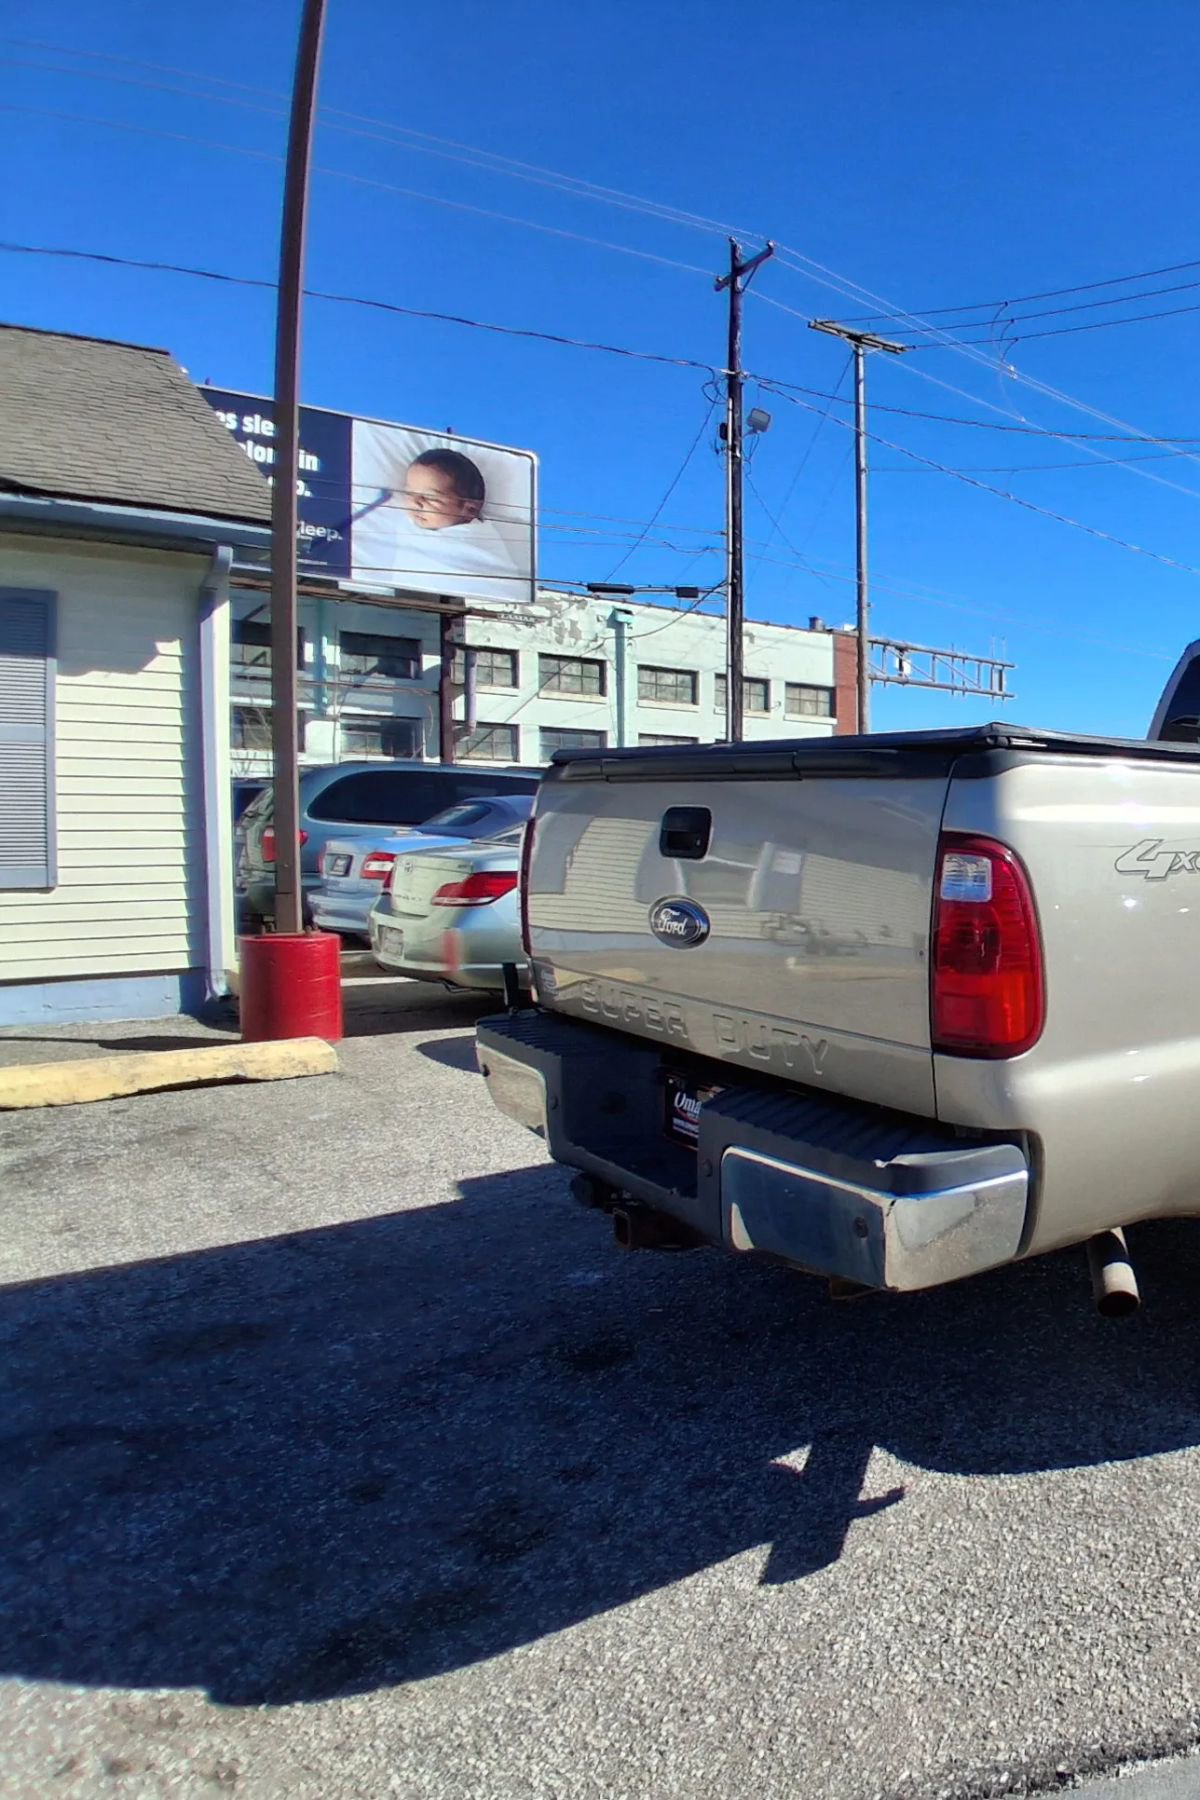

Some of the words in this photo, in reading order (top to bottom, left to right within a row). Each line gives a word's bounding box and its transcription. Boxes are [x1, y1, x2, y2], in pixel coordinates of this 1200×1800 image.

[299, 449, 319, 472] in
[297, 521, 343, 542] leep.
[658, 907, 689, 936] Ford
[580, 978, 689, 1039] SUPER
[712, 1013, 829, 1076] DUTY
